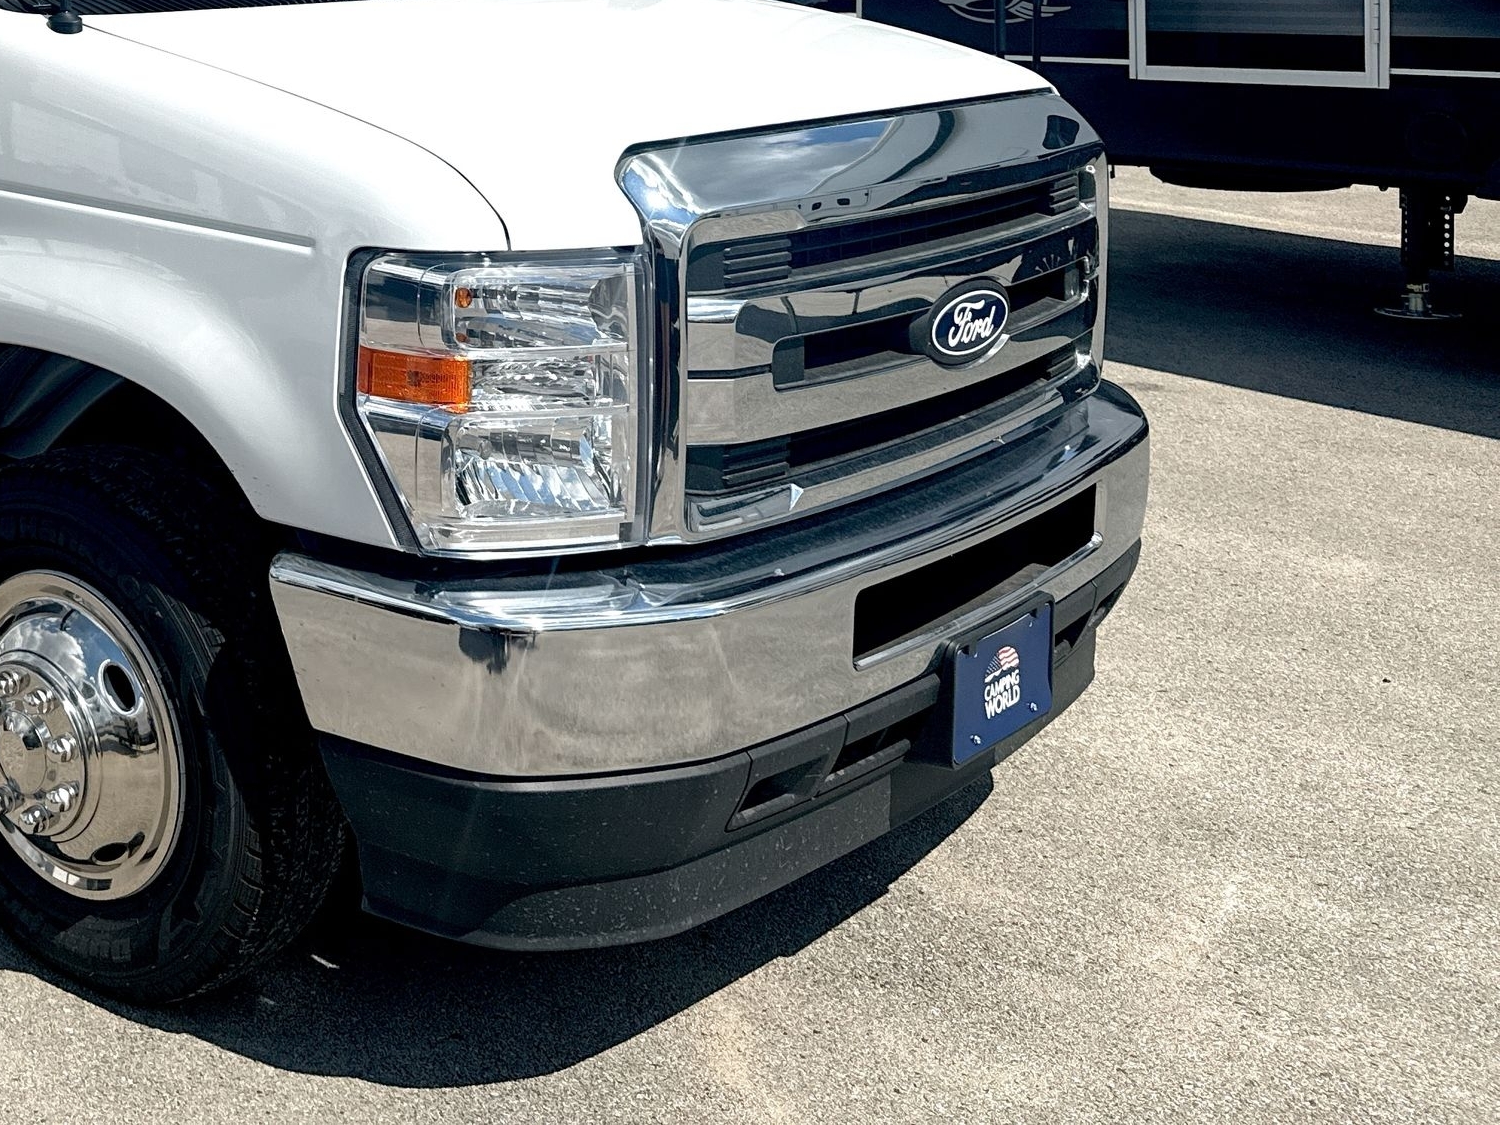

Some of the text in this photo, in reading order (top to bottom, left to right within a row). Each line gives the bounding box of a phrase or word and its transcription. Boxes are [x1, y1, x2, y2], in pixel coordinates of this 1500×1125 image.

[948, 299, 996, 348] Ford
[984, 669, 1020, 701] CAMPING
[984, 685, 1021, 720] WORLD
